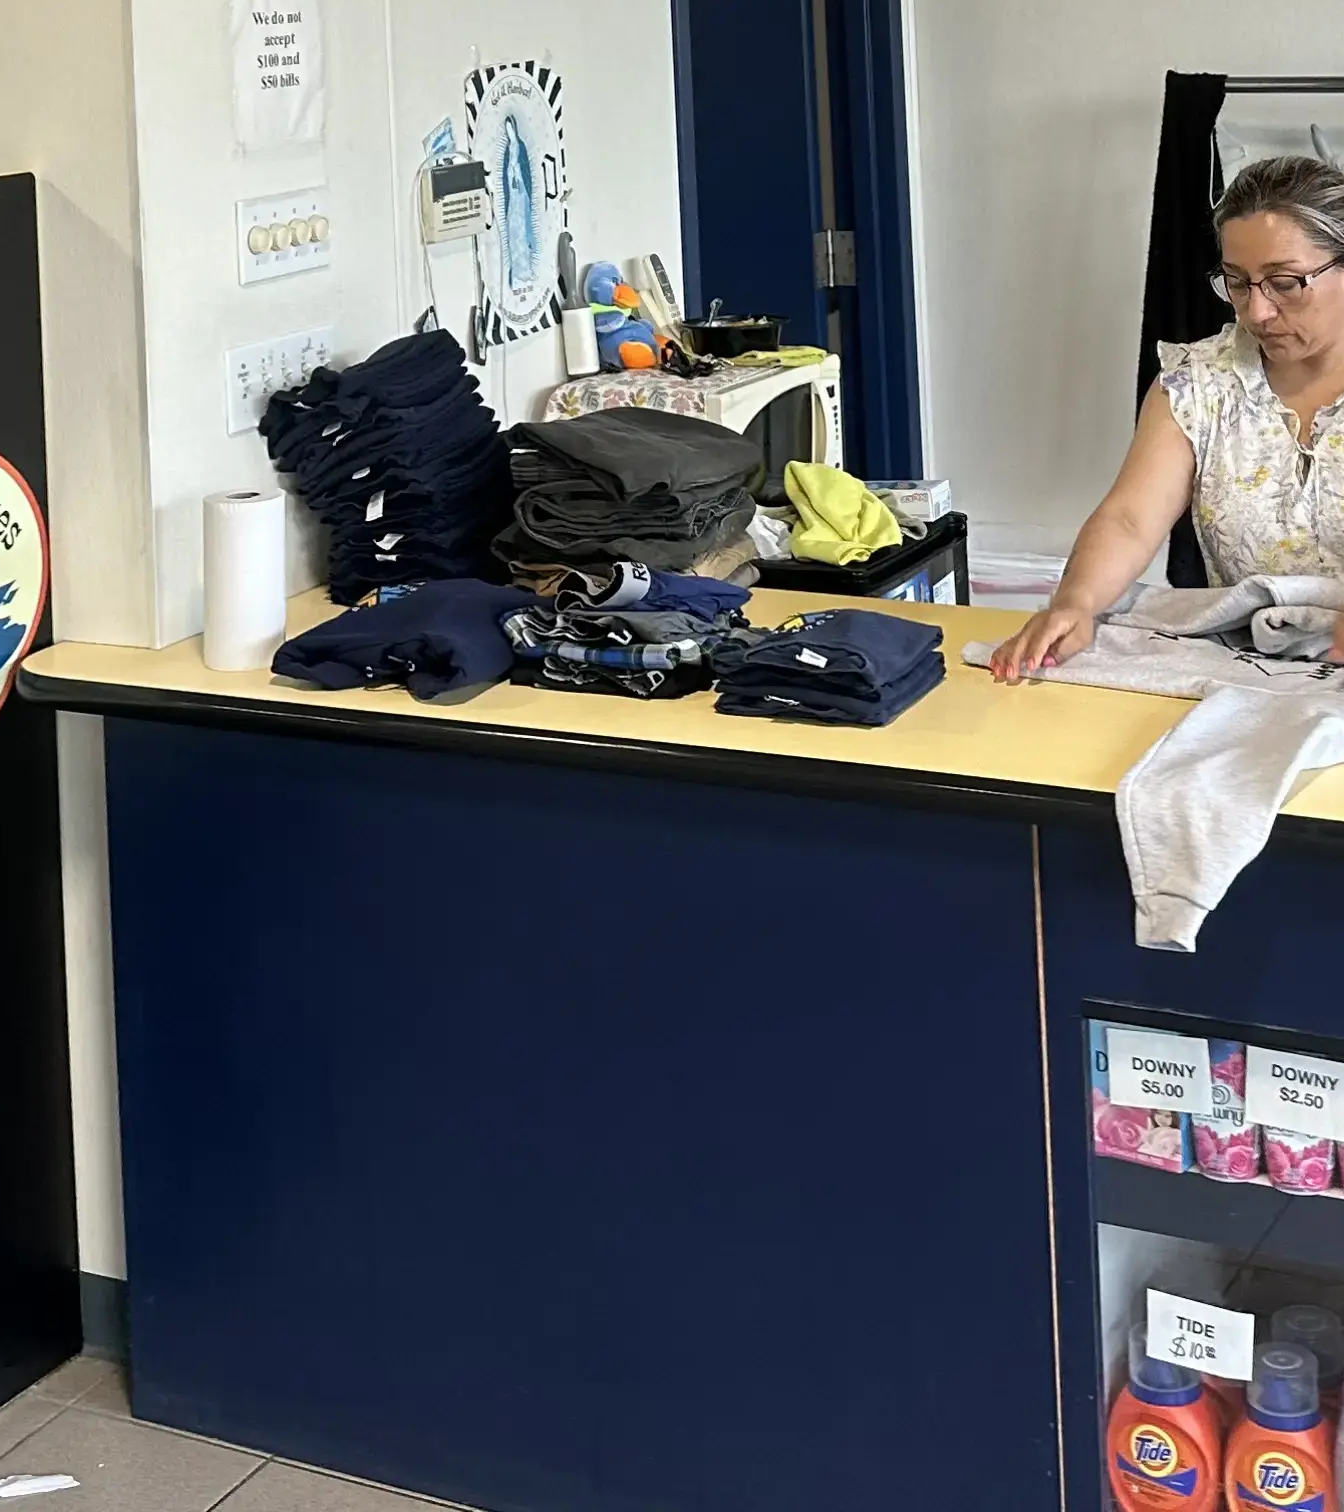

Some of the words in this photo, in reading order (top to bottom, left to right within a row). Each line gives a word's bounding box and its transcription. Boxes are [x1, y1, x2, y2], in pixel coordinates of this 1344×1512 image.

[252, 11, 270, 25] We
[271, 10, 284, 24] do
[287, 10, 302, 24] not
[264, 32, 296, 48] accept
[256, 53, 279, 69] $100
[281, 51, 300, 66] and
[261, 74, 278, 89] $50
[280, 72, 300, 88] bills
[1132, 1057, 1197, 1078] DOWNY
[1272, 1063, 1340, 1091] DOWNY
[1141, 1079, 1184, 1098] $5.00
[1279, 1087, 1324, 1110] $2.50
[1176, 1315, 1216, 1339] TIDE
[1135, 1435, 1172, 1462] Tide
[1258, 1464, 1300, 1490] Tide
